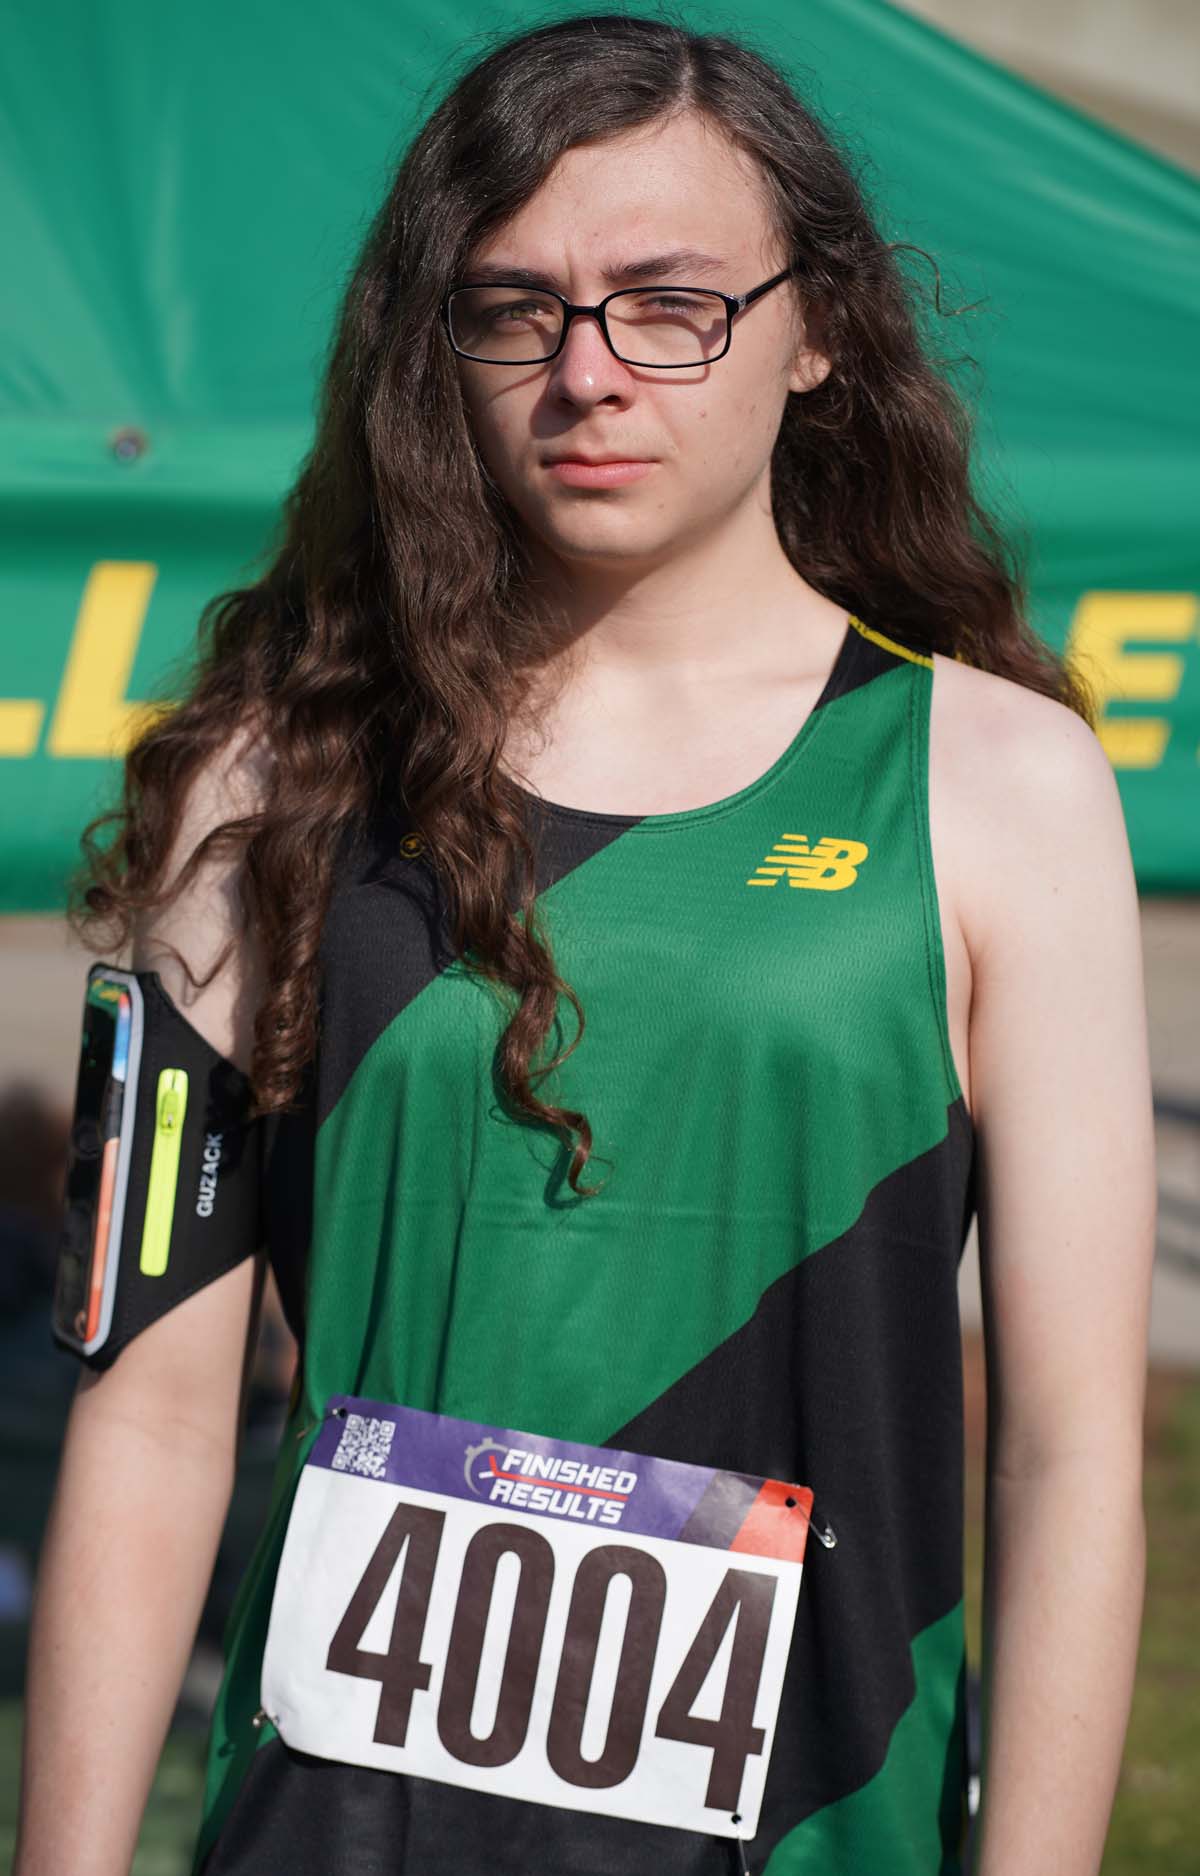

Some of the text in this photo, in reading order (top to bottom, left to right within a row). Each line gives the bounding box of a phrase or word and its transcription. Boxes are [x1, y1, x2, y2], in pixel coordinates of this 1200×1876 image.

[196, 1132, 223, 1218] GUZACK
[489, 1478, 625, 1524] RESULTS
[502, 1449, 638, 1495] FINISHED
[325, 1501, 778, 1813] 4004
